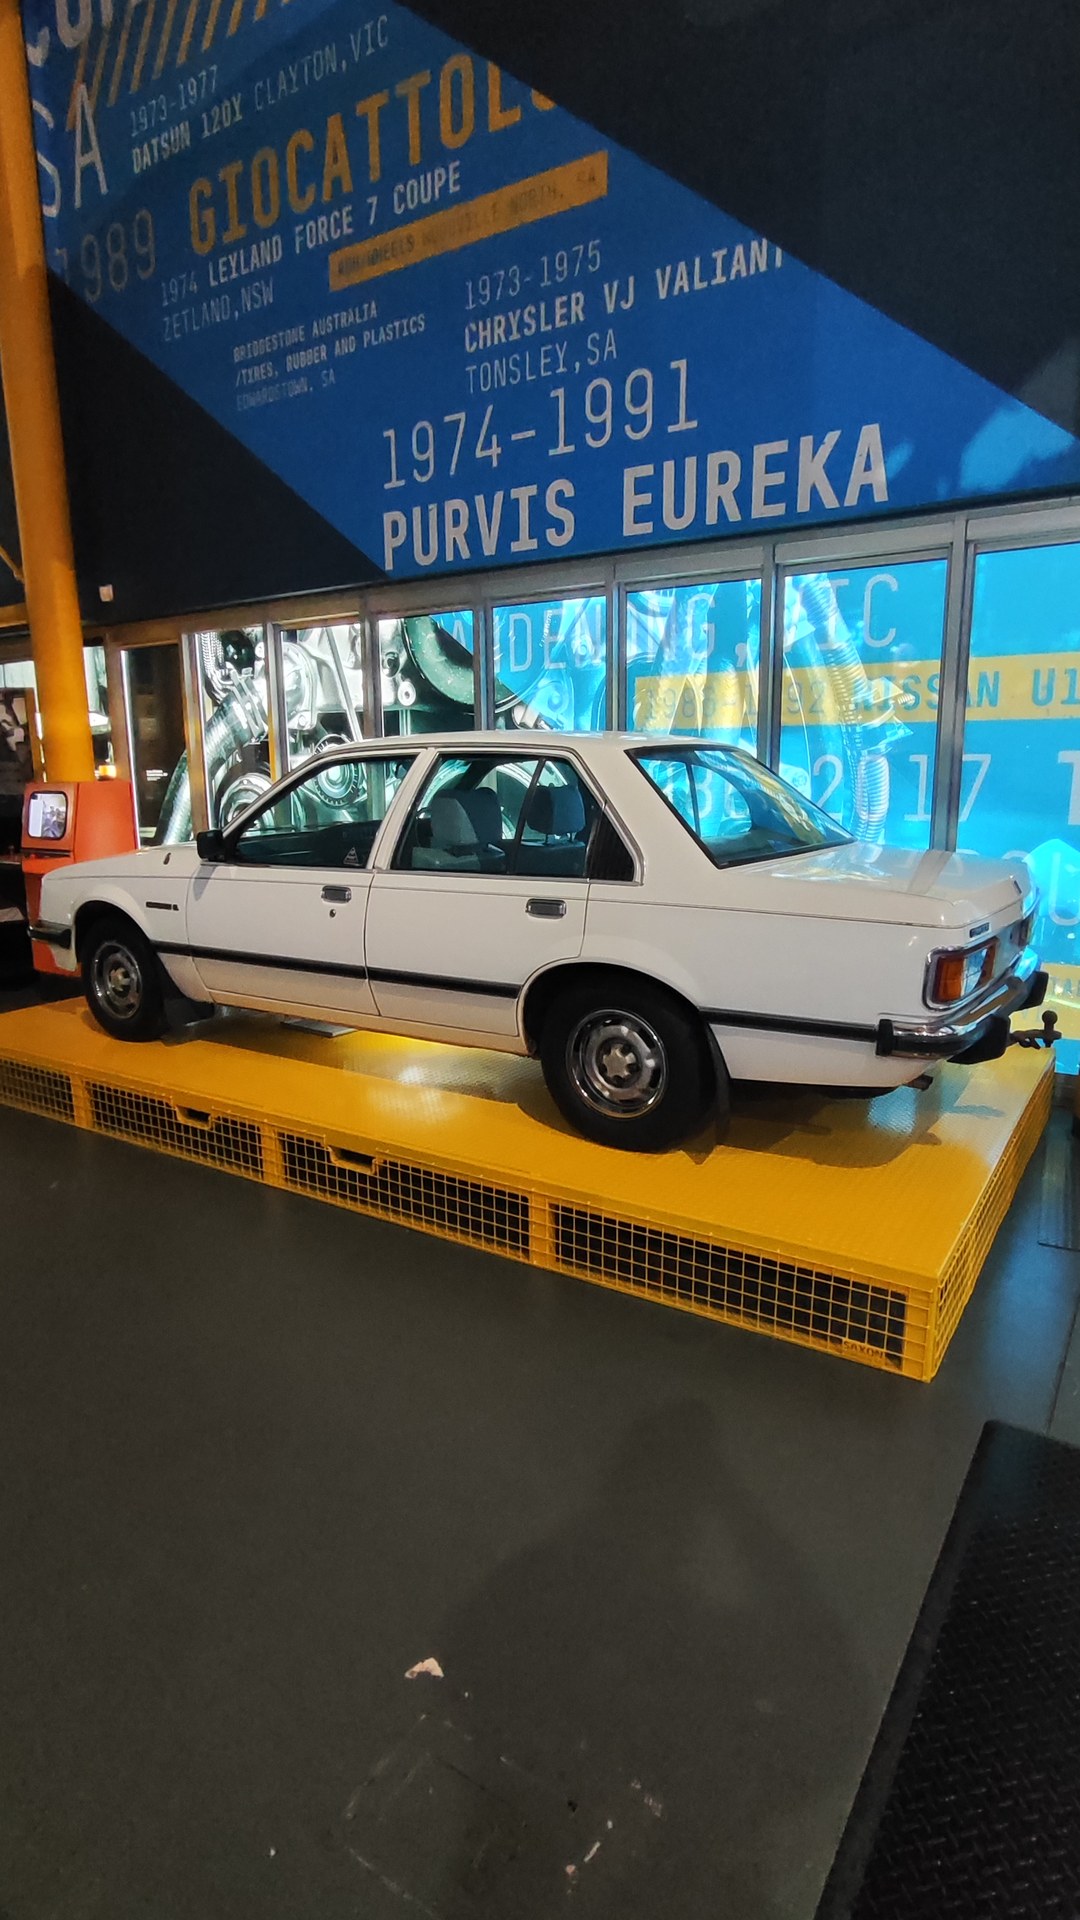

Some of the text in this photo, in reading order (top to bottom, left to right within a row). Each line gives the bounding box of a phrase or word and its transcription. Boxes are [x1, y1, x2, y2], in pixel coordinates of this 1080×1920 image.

[130, 64, 218, 137] 1973-1977
[131, 121, 191, 174] DATSUN
[201, 93, 243, 139] 120Y
[188, 53, 557, 256] GIOCATTOL
[161, 271, 198, 307] 1974
[208, 235, 283, 287] LEYLAND
[294, 205, 353, 254] FORCE
[366, 196, 378, 225] 7
[393, 160, 461, 215] COUPE
[464, 239, 601, 311] 1973-1975
[464, 290, 585, 353] CHRYSLER
[603, 275, 635, 314] VJ
[233, 300, 378, 363] BRIDGESTONE AUSTRALIA
[286, 344, 327, 373] RUBBER
[334, 335, 356, 358] AND
[363, 313, 426, 349] PLASTICS
[382, 358, 698, 490] 1974-1991
[382, 423, 890, 571] PURVIS EUREKA
